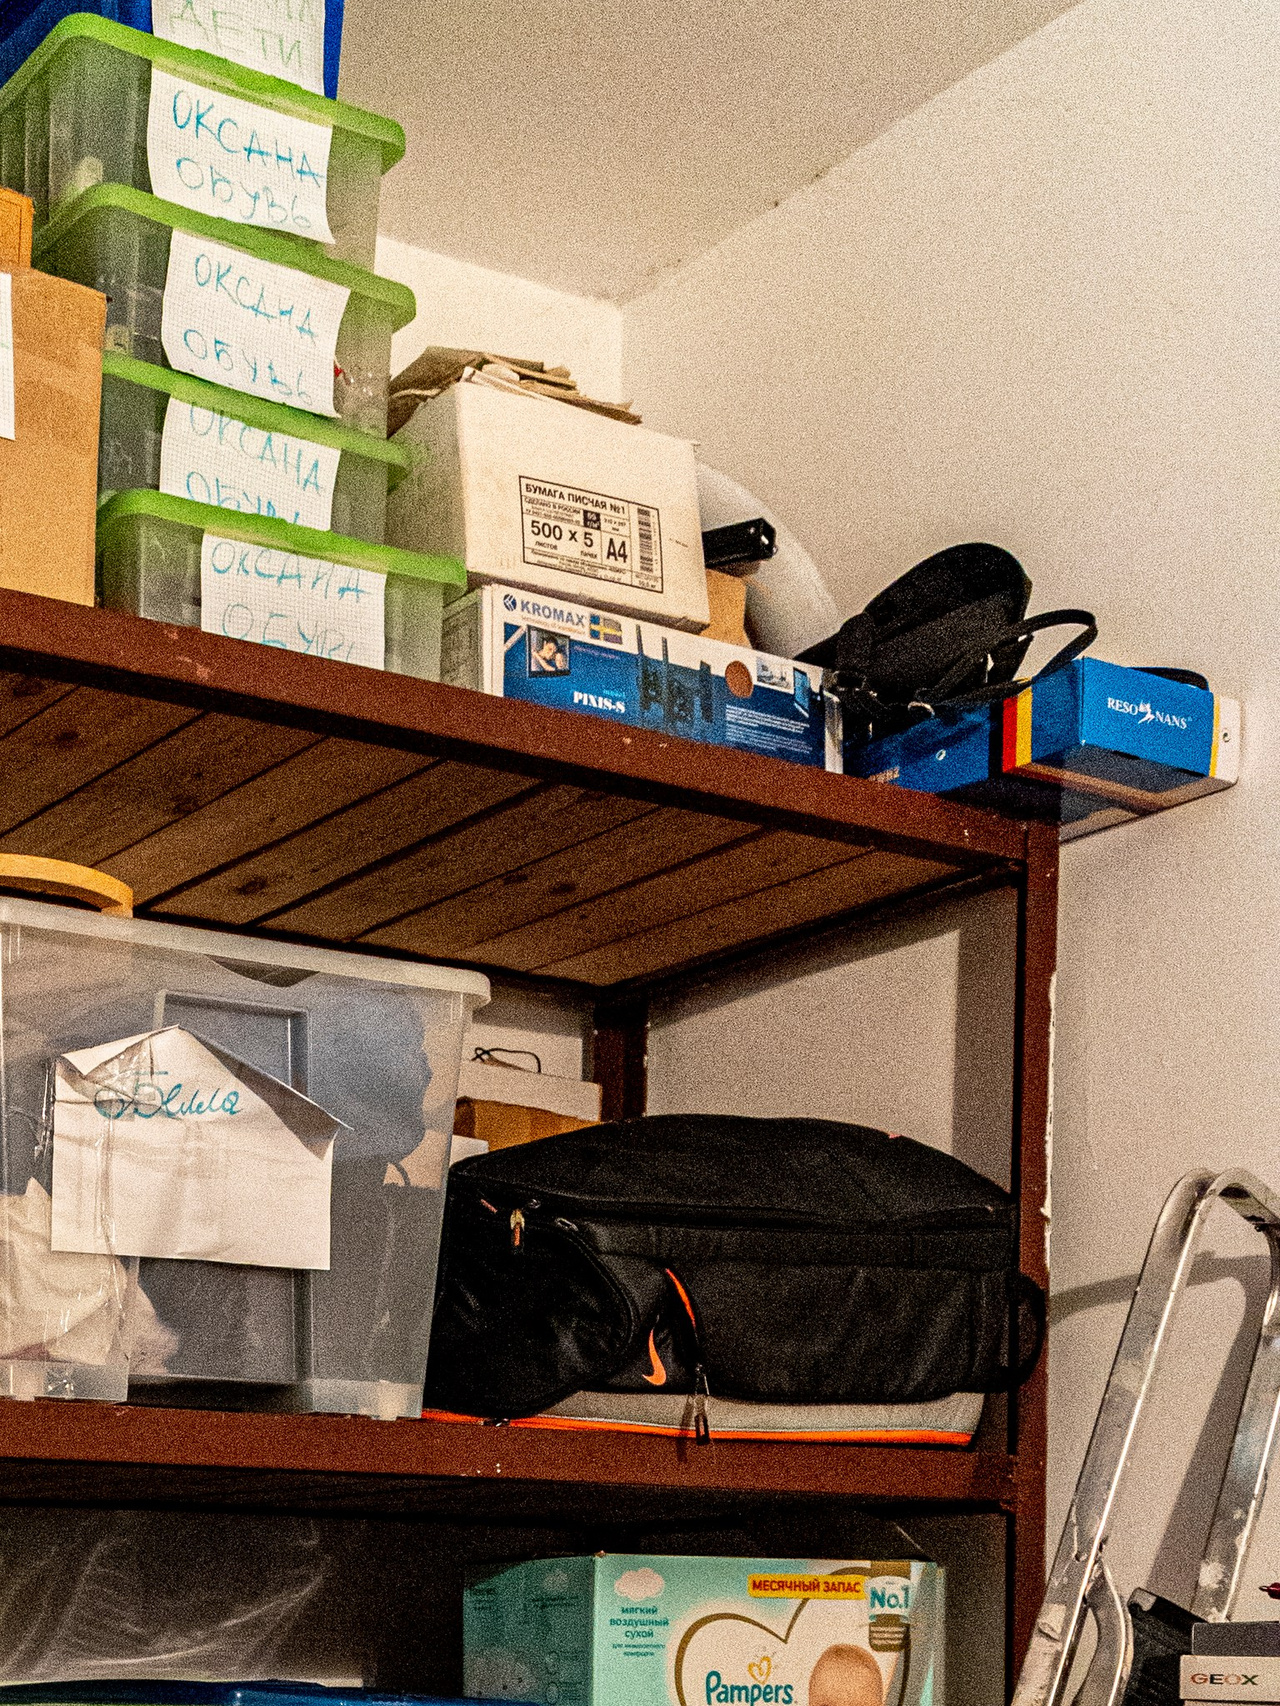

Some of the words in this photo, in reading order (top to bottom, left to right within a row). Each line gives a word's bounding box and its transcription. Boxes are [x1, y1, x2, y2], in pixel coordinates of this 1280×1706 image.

[173, 90, 326, 188] ОКСАНА
[176, 157, 312, 229] ОБУВЬ
[194, 253, 319, 346] ОКСАНА
[525, 483, 565, 500] БУМАГА
[568, 493, 607, 510] ПИСЧАЯ
[531, 520, 563, 541] 500
[583, 532, 594, 548] 5
[520, 600, 585, 627] KROMAX
[573, 690, 626, 714] PIXIS-S
[751, 1578, 820, 1593] МЕСЯЧНЫЙ
[822, 1580, 863, 1594] ЗАПАС
[609, 1617, 670, 1629] воздушный
[624, 1629, 654, 1640] сухой
[1190, 1673, 1258, 1686] GEOX
